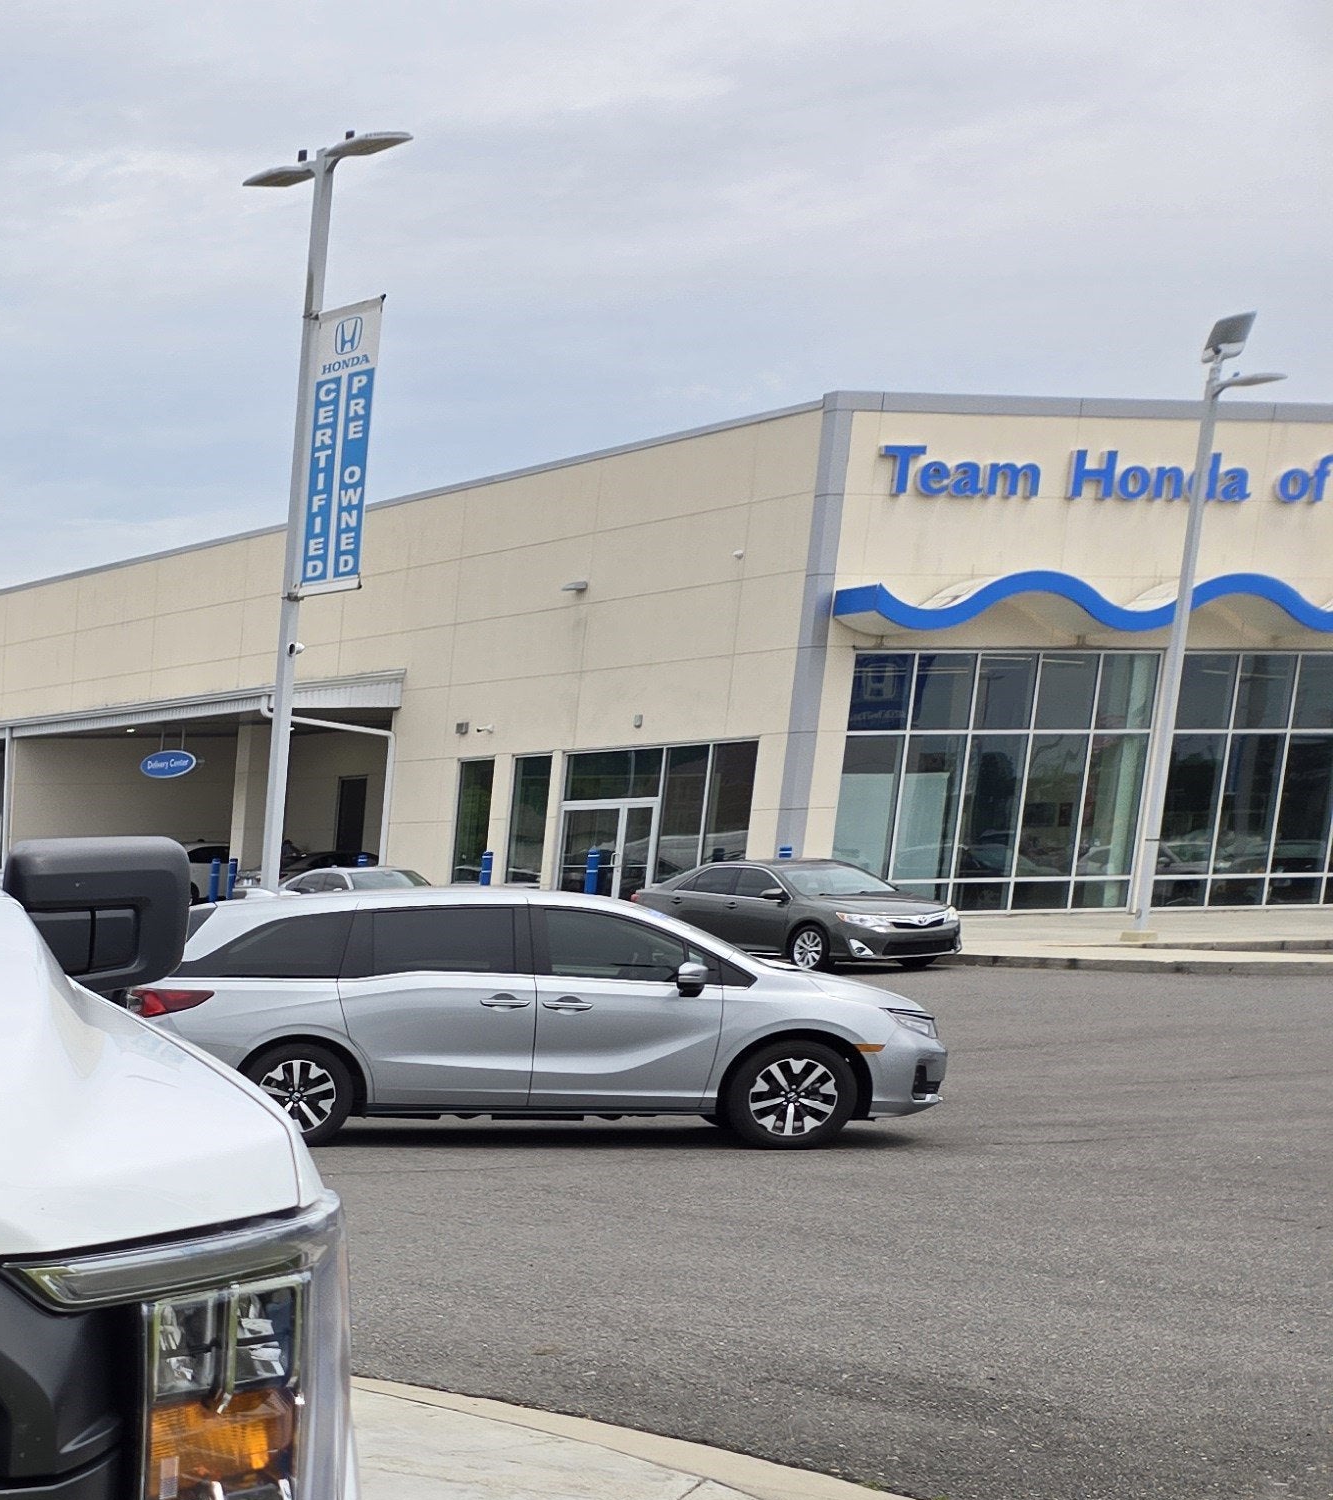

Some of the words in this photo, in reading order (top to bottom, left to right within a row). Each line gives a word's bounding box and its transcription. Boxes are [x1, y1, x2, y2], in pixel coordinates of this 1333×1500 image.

[320, 353, 370, 376] HONDA
[347, 374, 368, 440] PRE
[305, 382, 338, 579] CERTIFIED
[879, 444, 1042, 498] Team
[1066, 448, 1252, 501] Honda
[339, 465, 363, 574] OWNED
[147, 760, 169, 770] Delivery
[169, 758, 189, 768] Center
